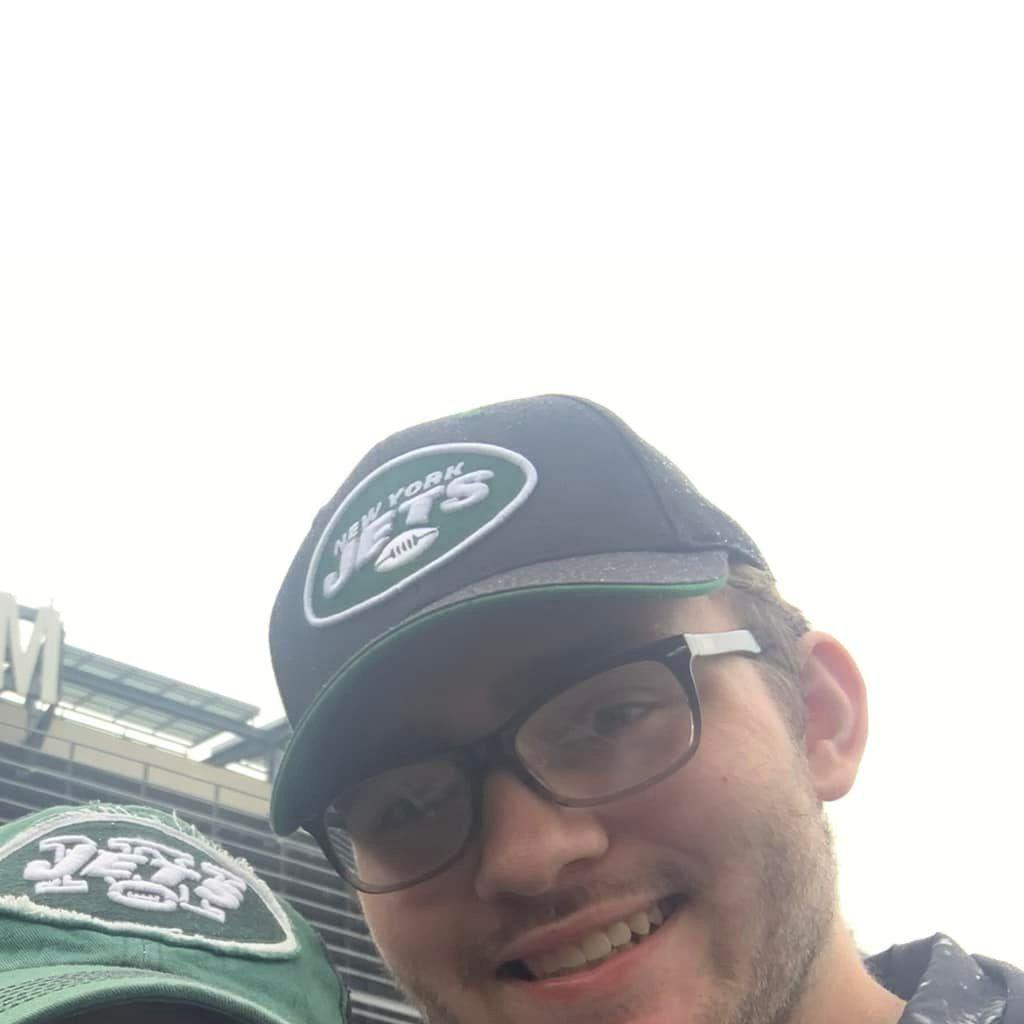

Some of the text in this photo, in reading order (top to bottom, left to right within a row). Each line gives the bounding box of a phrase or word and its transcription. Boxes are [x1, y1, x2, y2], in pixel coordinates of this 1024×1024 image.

[323, 469, 494, 599] JETS
[334, 462, 465, 557] NEW YORK
